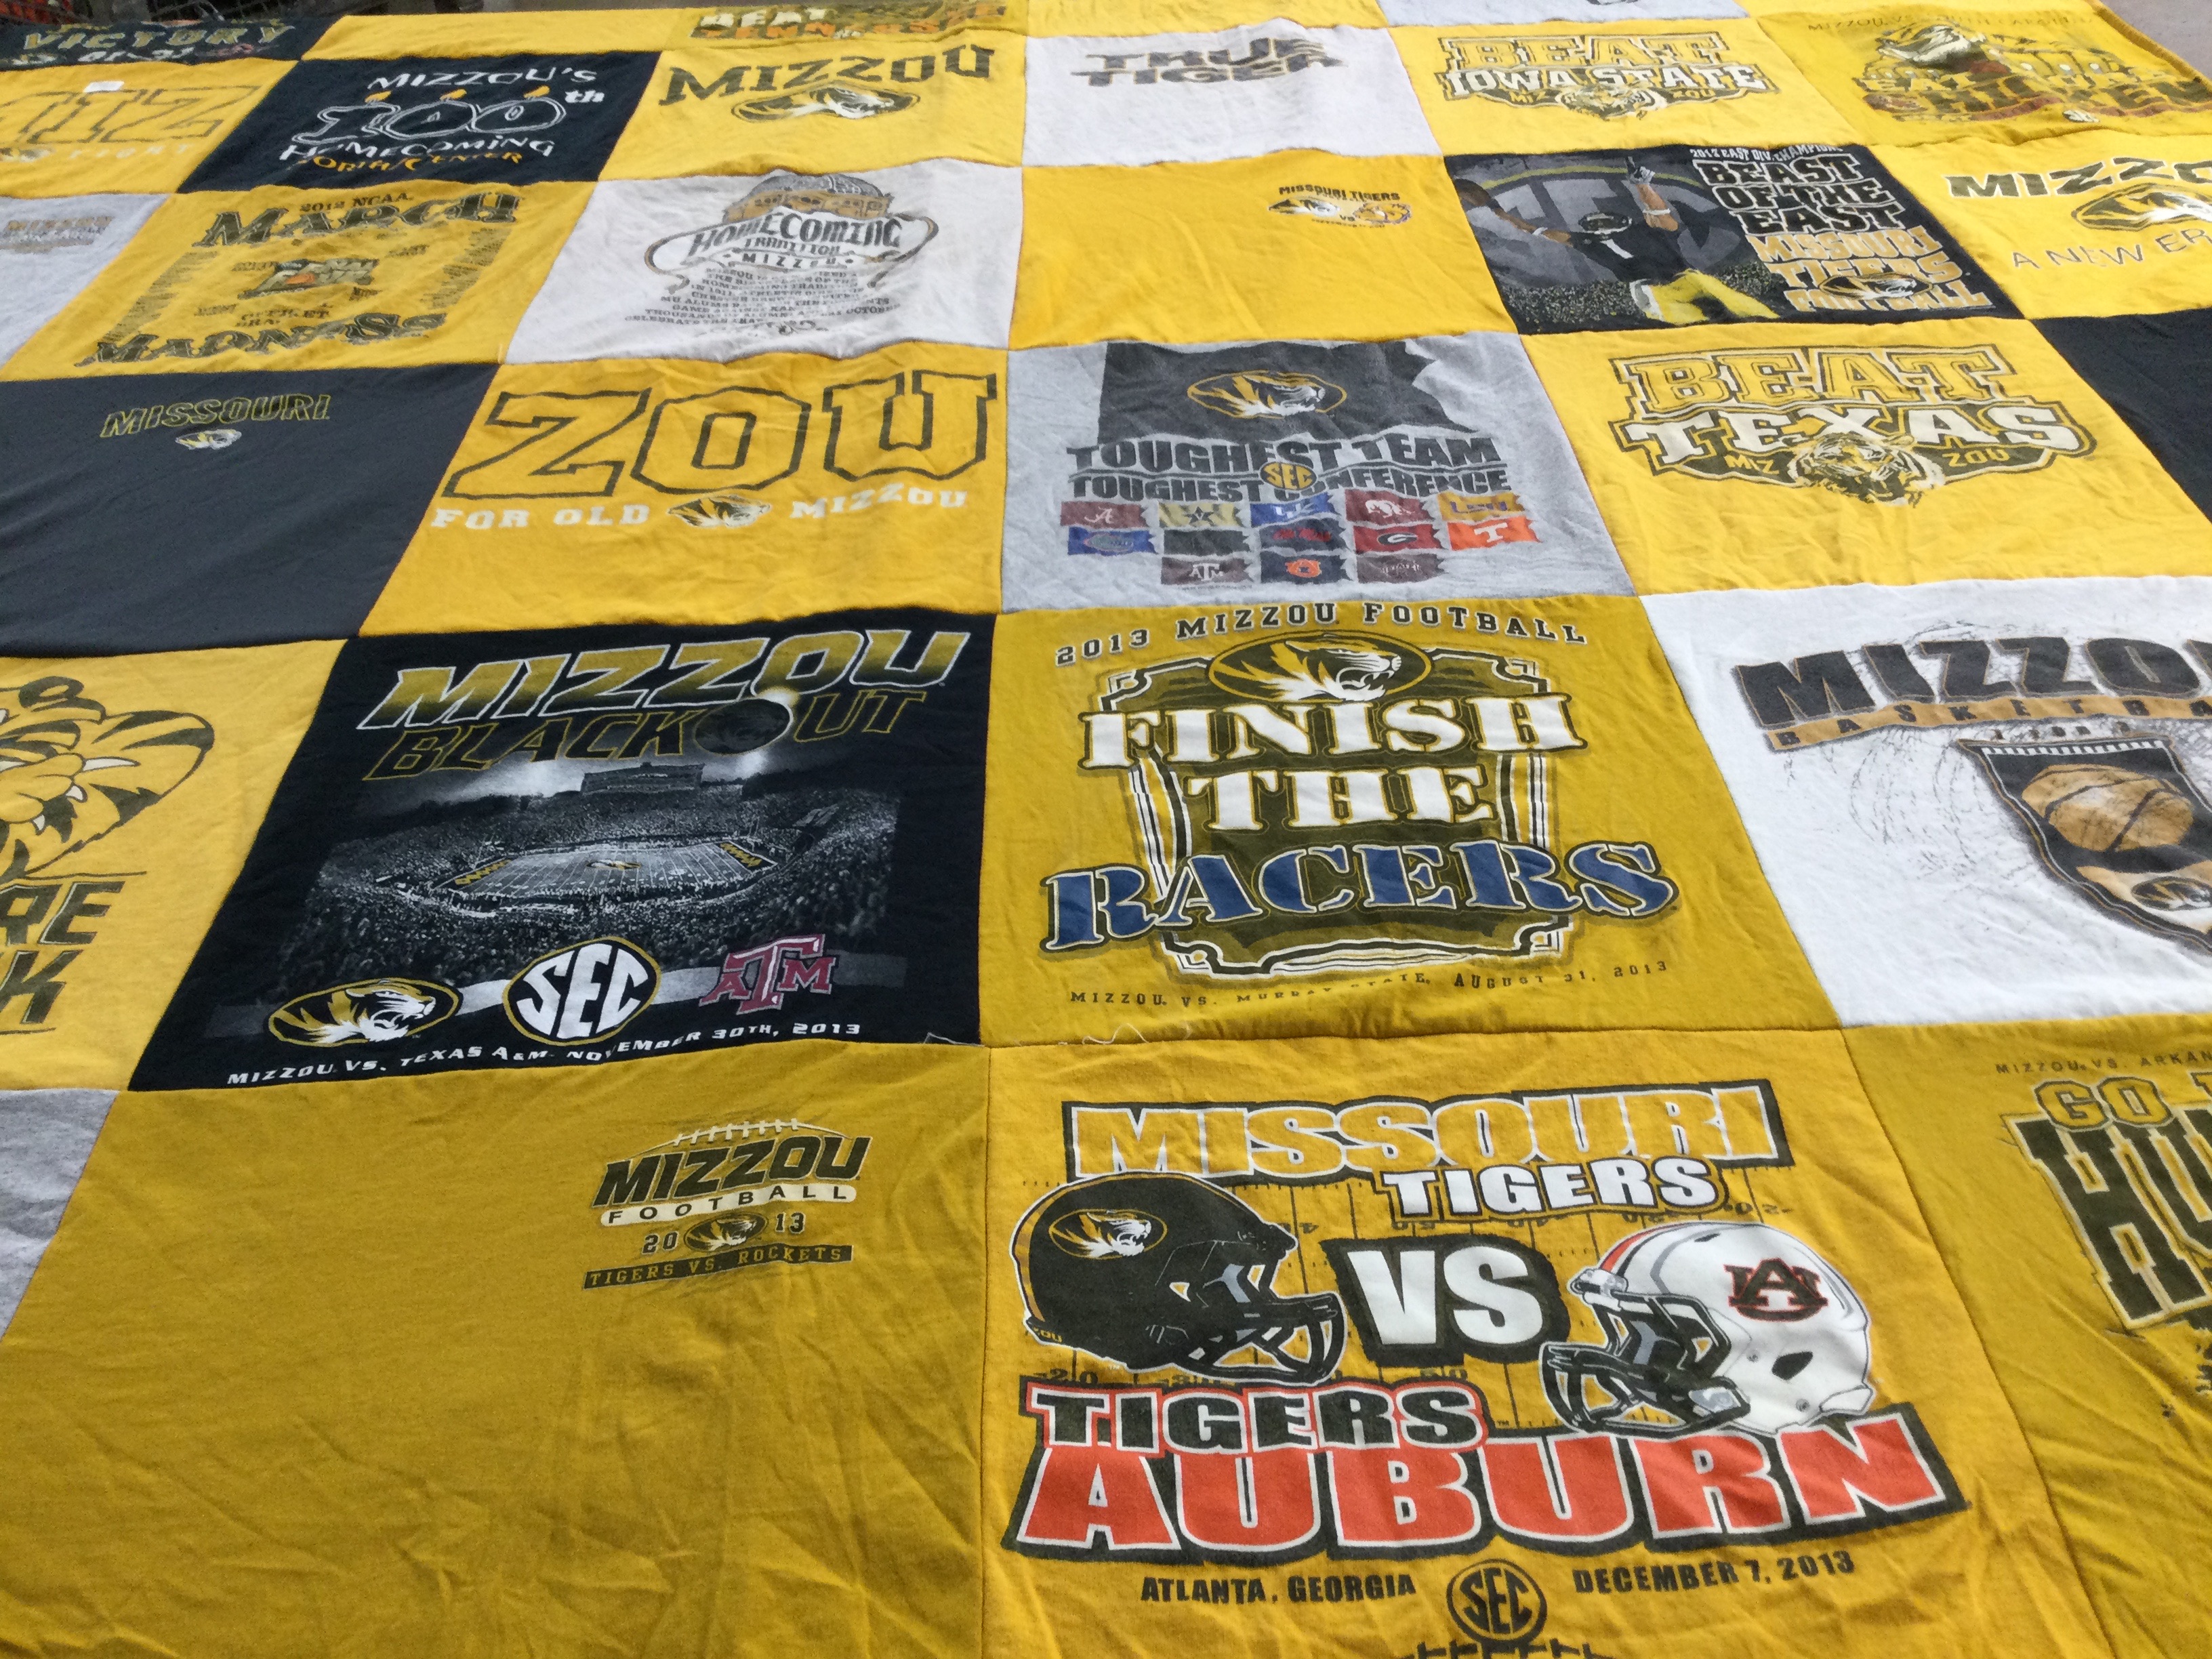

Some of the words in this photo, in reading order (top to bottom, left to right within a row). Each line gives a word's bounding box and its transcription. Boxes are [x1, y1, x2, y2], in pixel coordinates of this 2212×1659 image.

[24, 26, 295, 49] VICTORY
[1442, 33, 1728, 68] BEAT
[368, 66, 598, 88] MIZZOU'S
[565, 89, 606, 104] th
[659, 45, 995, 106] MIZZOU
[1440, 68, 1583, 97] IOWA
[1591, 64, 1769, 91] STATE
[1693, 153, 1861, 186] BEAST
[1721, 147, 1750, 161] EAST
[1279, 184, 1347, 201] MISSOURI
[1712, 182, 1780, 211] OF
[1778, 177, 1896, 207] THE
[192, 192, 522, 248] MARCH
[687, 211, 903, 258] HOMECOMING
[1729, 202, 1906, 236] EAST
[1746, 224, 1943, 264] MISSOURI
[1610, 346, 2014, 417] BEAT
[100, 394, 331, 438] MISSOURI
[441, 370, 998, 497] ZOU
[1626, 407, 2082, 464] TEXAS
[1066, 437, 1343, 475] TOUGHEST
[1351, 432, 1503, 468] TEAM
[1262, 463, 1314, 490] SEC
[1725, 454, 1781, 474] MIZ
[1947, 448, 2011, 468] ZOU
[430, 507, 530, 531] FOR
[552, 504, 651, 527] OLD
[789, 483, 969, 520] MIZZOU
[1068, 475, 1265, 502] TOUGHEST
[1055, 628, 1151, 667] 2013
[1174, 602, 1339, 640] MIZZOU
[1363, 602, 1591, 644] FOOTBALL
[356, 628, 972, 730] MIZZOU
[1733, 636, 2212, 728] MIZZO
[1079, 693, 1589, 771] FINISH
[1186, 766, 1494, 832] THE
[1042, 840, 1677, 951] RACERS
[513, 942, 651, 1040] SEC
[1069, 991, 1167, 1006] MIZZOU
[1181, 996, 1218, 1007] VS.
[1613, 960, 1667, 978] 2013
[227, 1063, 335, 1085] MIZZOU
[344, 1059, 386, 1072] VS.
[400, 1046, 483, 1068] TEXAS
[566, 1031, 702, 1061] NOVEMBER
[712, 1024, 779, 1040] 30TH,
[792, 1022, 862, 1036] 2013
[2032, 1075, 2175, 1133] GO
[1063, 1080, 1793, 1183] MISSOURI
[592, 1134, 874, 1209] MIZZOU
[1380, 1156, 1724, 1220] TIGERS
[607, 1185, 848, 1225] FOOTBALL
[641, 1231, 678, 1255] 20
[775, 1212, 806, 1234] 13
[590, 1258, 674, 1286] TIGERS
[738, 1246, 842, 1266] ROCKETS
[1354, 1243, 1545, 1347] VS
[1029, 1384, 1484, 1454] TIGERS
[1017, 1413, 1946, 1553] AUBURN
[1141, 1576, 1278, 1604] ATLANTA,
[1287, 1574, 1417, 1603] GEORGIA
[1572, 1559, 1740, 1595] DECEMBER
[1744, 1559, 1771, 1584] 7,
[1776, 1549, 1856, 1581] 2013
[1457, 1567, 1533, 1636] SEC
